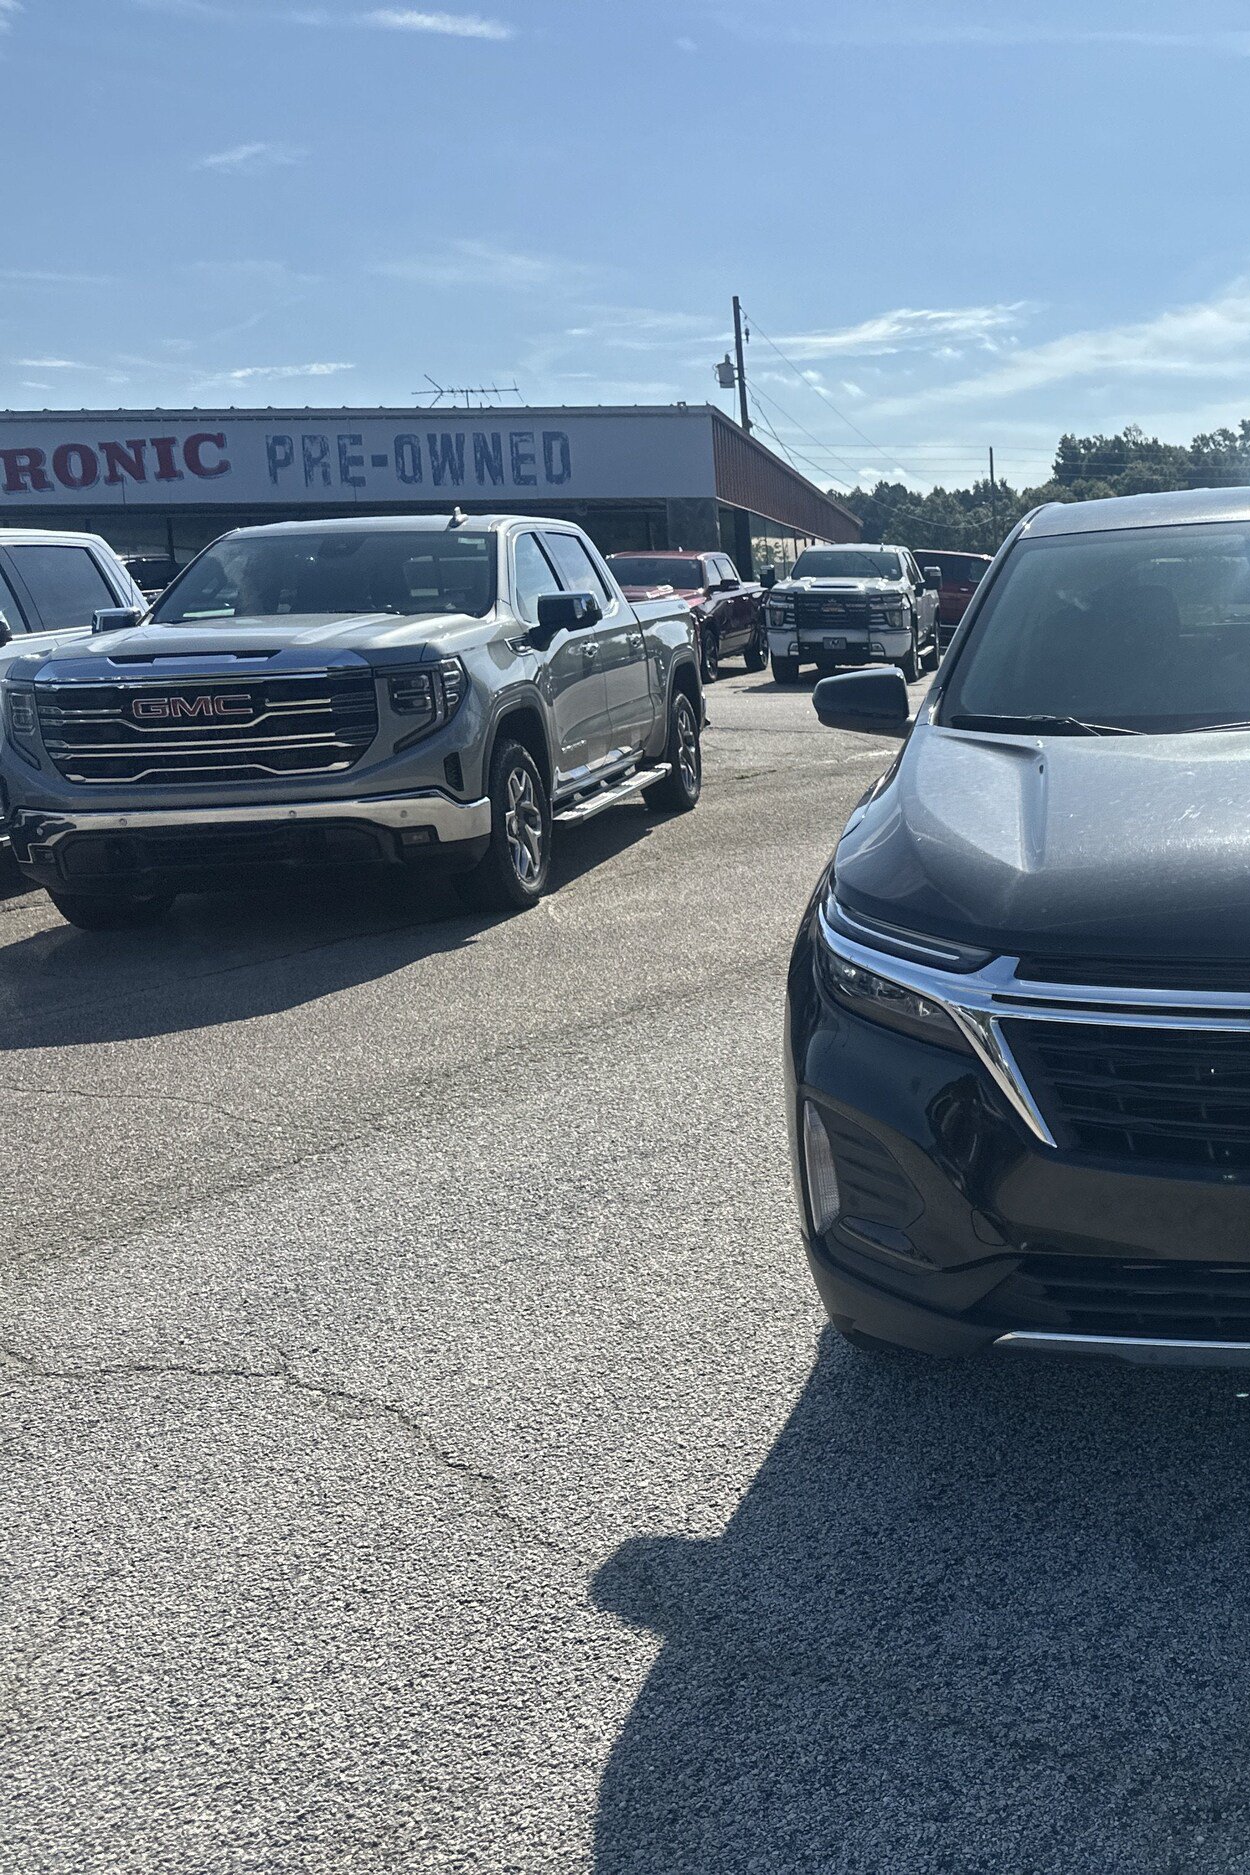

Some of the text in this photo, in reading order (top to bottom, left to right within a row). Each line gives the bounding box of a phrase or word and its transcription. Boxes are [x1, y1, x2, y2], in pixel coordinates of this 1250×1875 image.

[0, 431, 572, 494] RONIC PRE-OWNED
[132, 694, 253, 719] GMC
